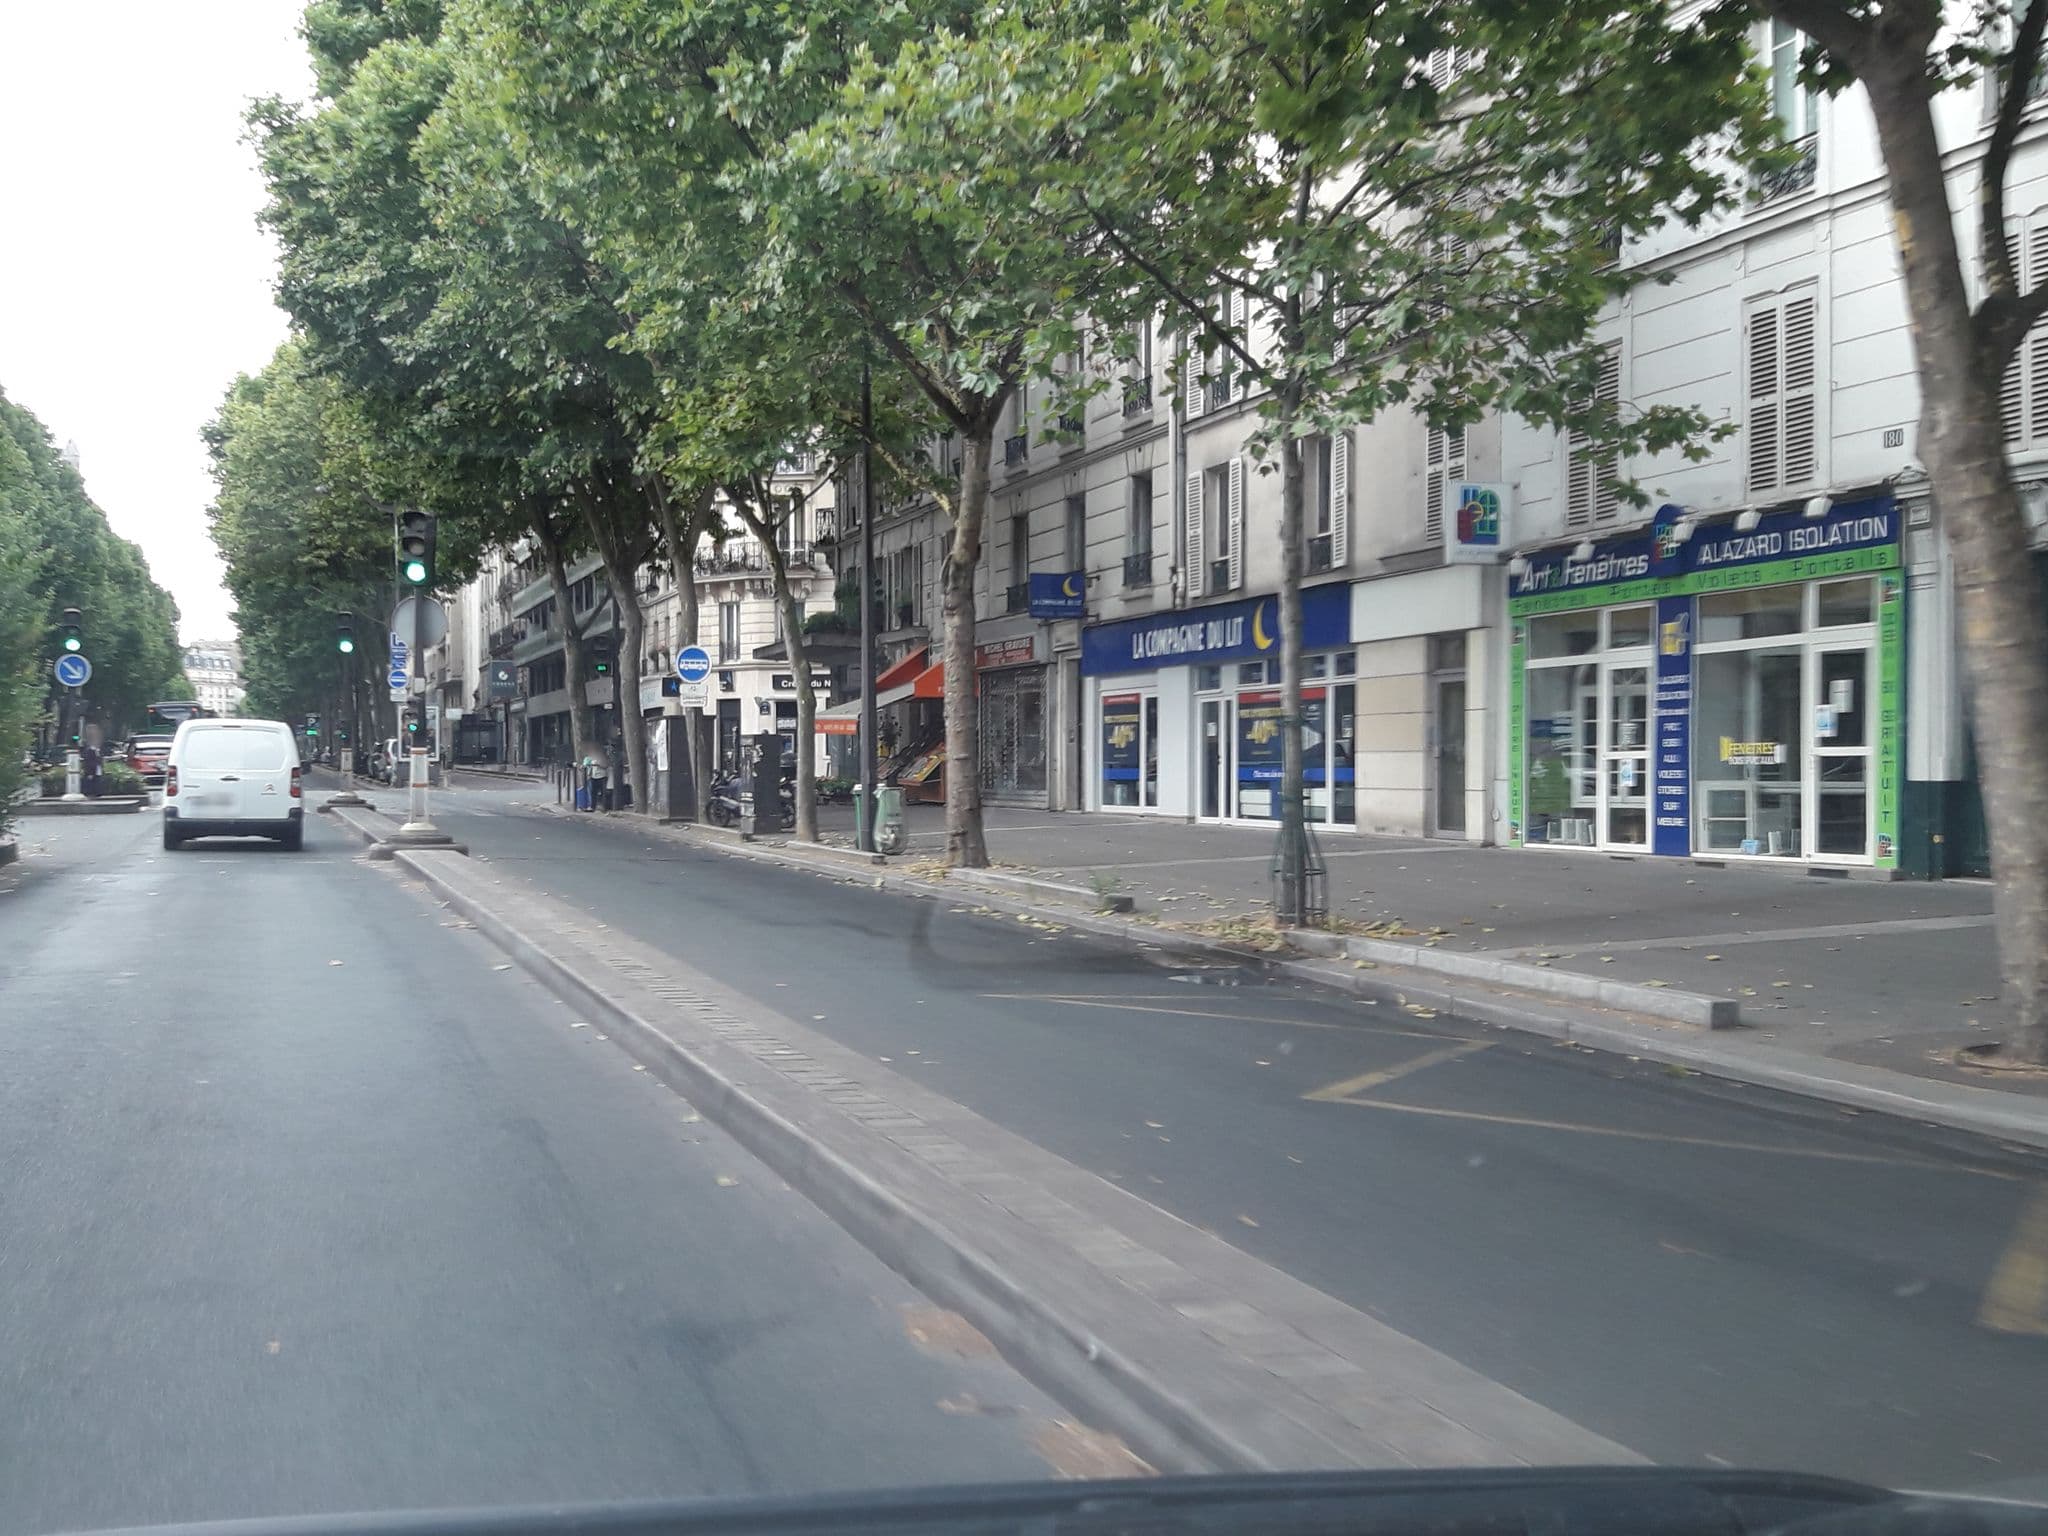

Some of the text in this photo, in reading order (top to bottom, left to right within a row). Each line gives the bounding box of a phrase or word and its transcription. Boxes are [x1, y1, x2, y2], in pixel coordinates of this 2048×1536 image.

[1884, 429, 1903, 448] 180
[1699, 515, 1888, 565] ALAZARD ISOLATION
[1132, 616, 1244, 660] LA COMPAGNIE DU LIT
[810, 679, 822, 687] du
[1881, 710, 1897, 823] GRATUIT
